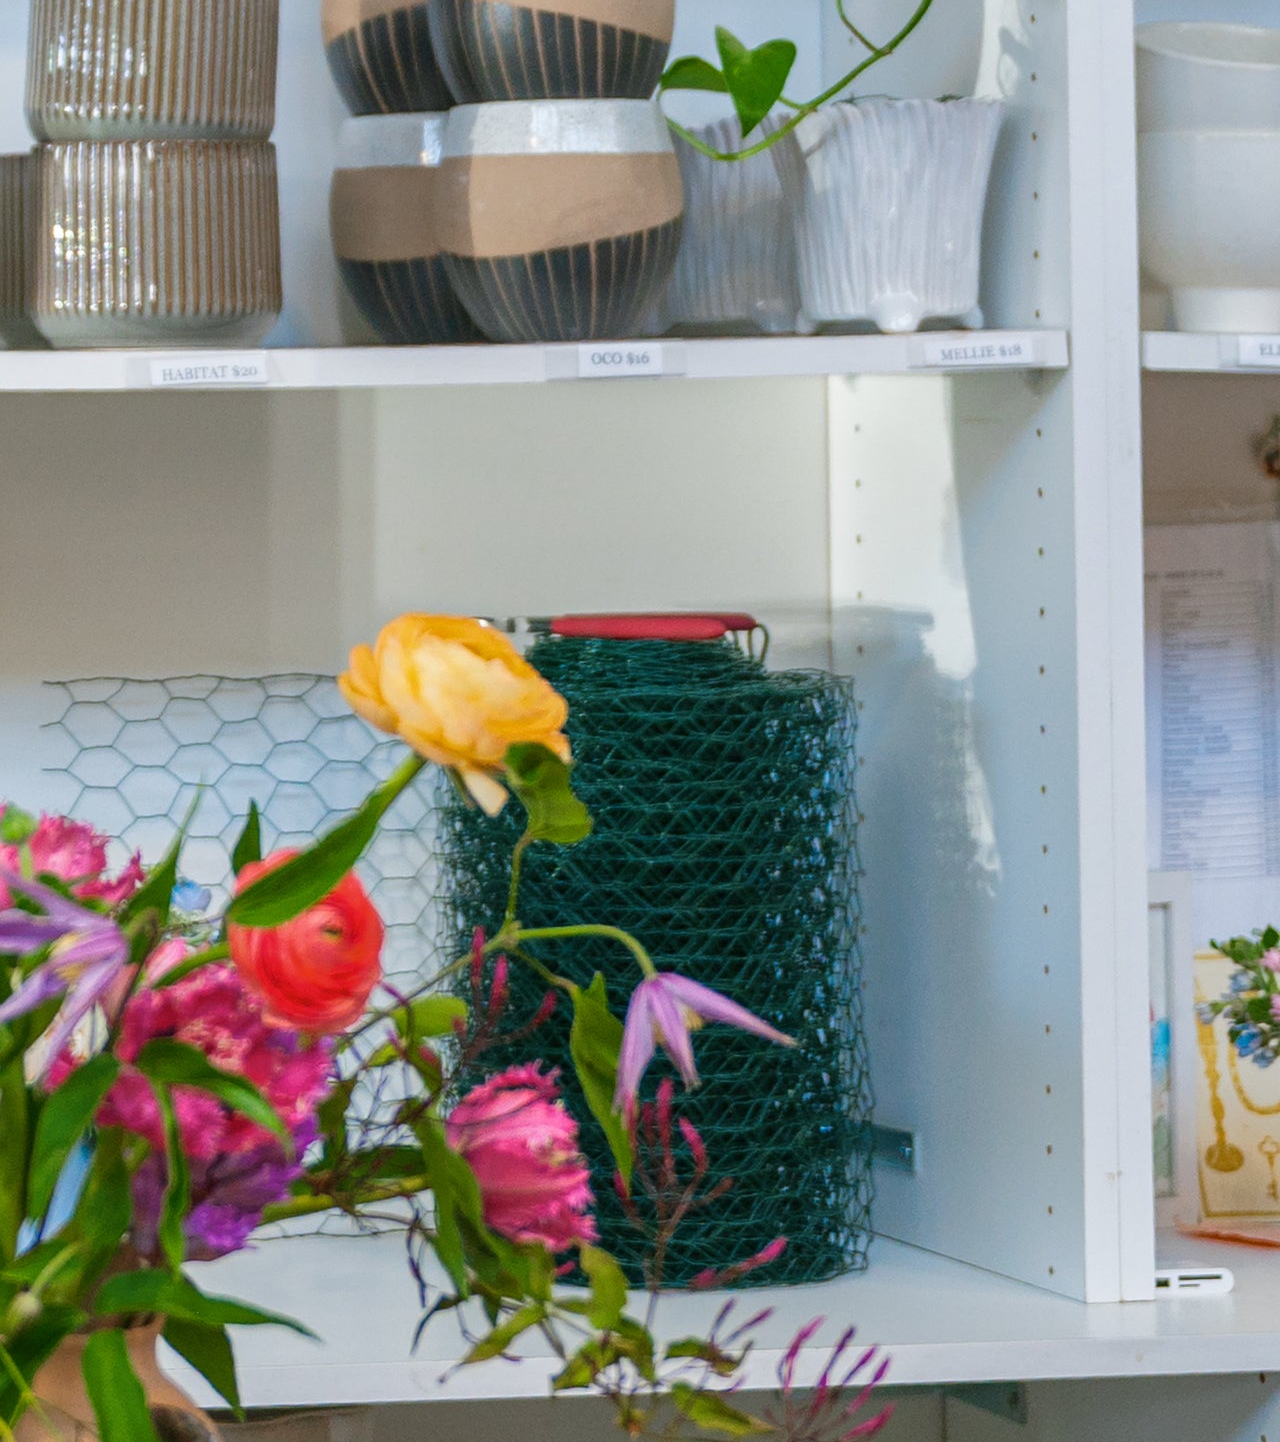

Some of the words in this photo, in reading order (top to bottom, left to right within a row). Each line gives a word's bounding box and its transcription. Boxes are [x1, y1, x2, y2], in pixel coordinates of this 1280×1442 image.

[591, 352, 622, 365] OCO
[626, 352, 650, 365] $16
[162, 365, 228, 382] HABITAT
[232, 365, 258, 377] $20
